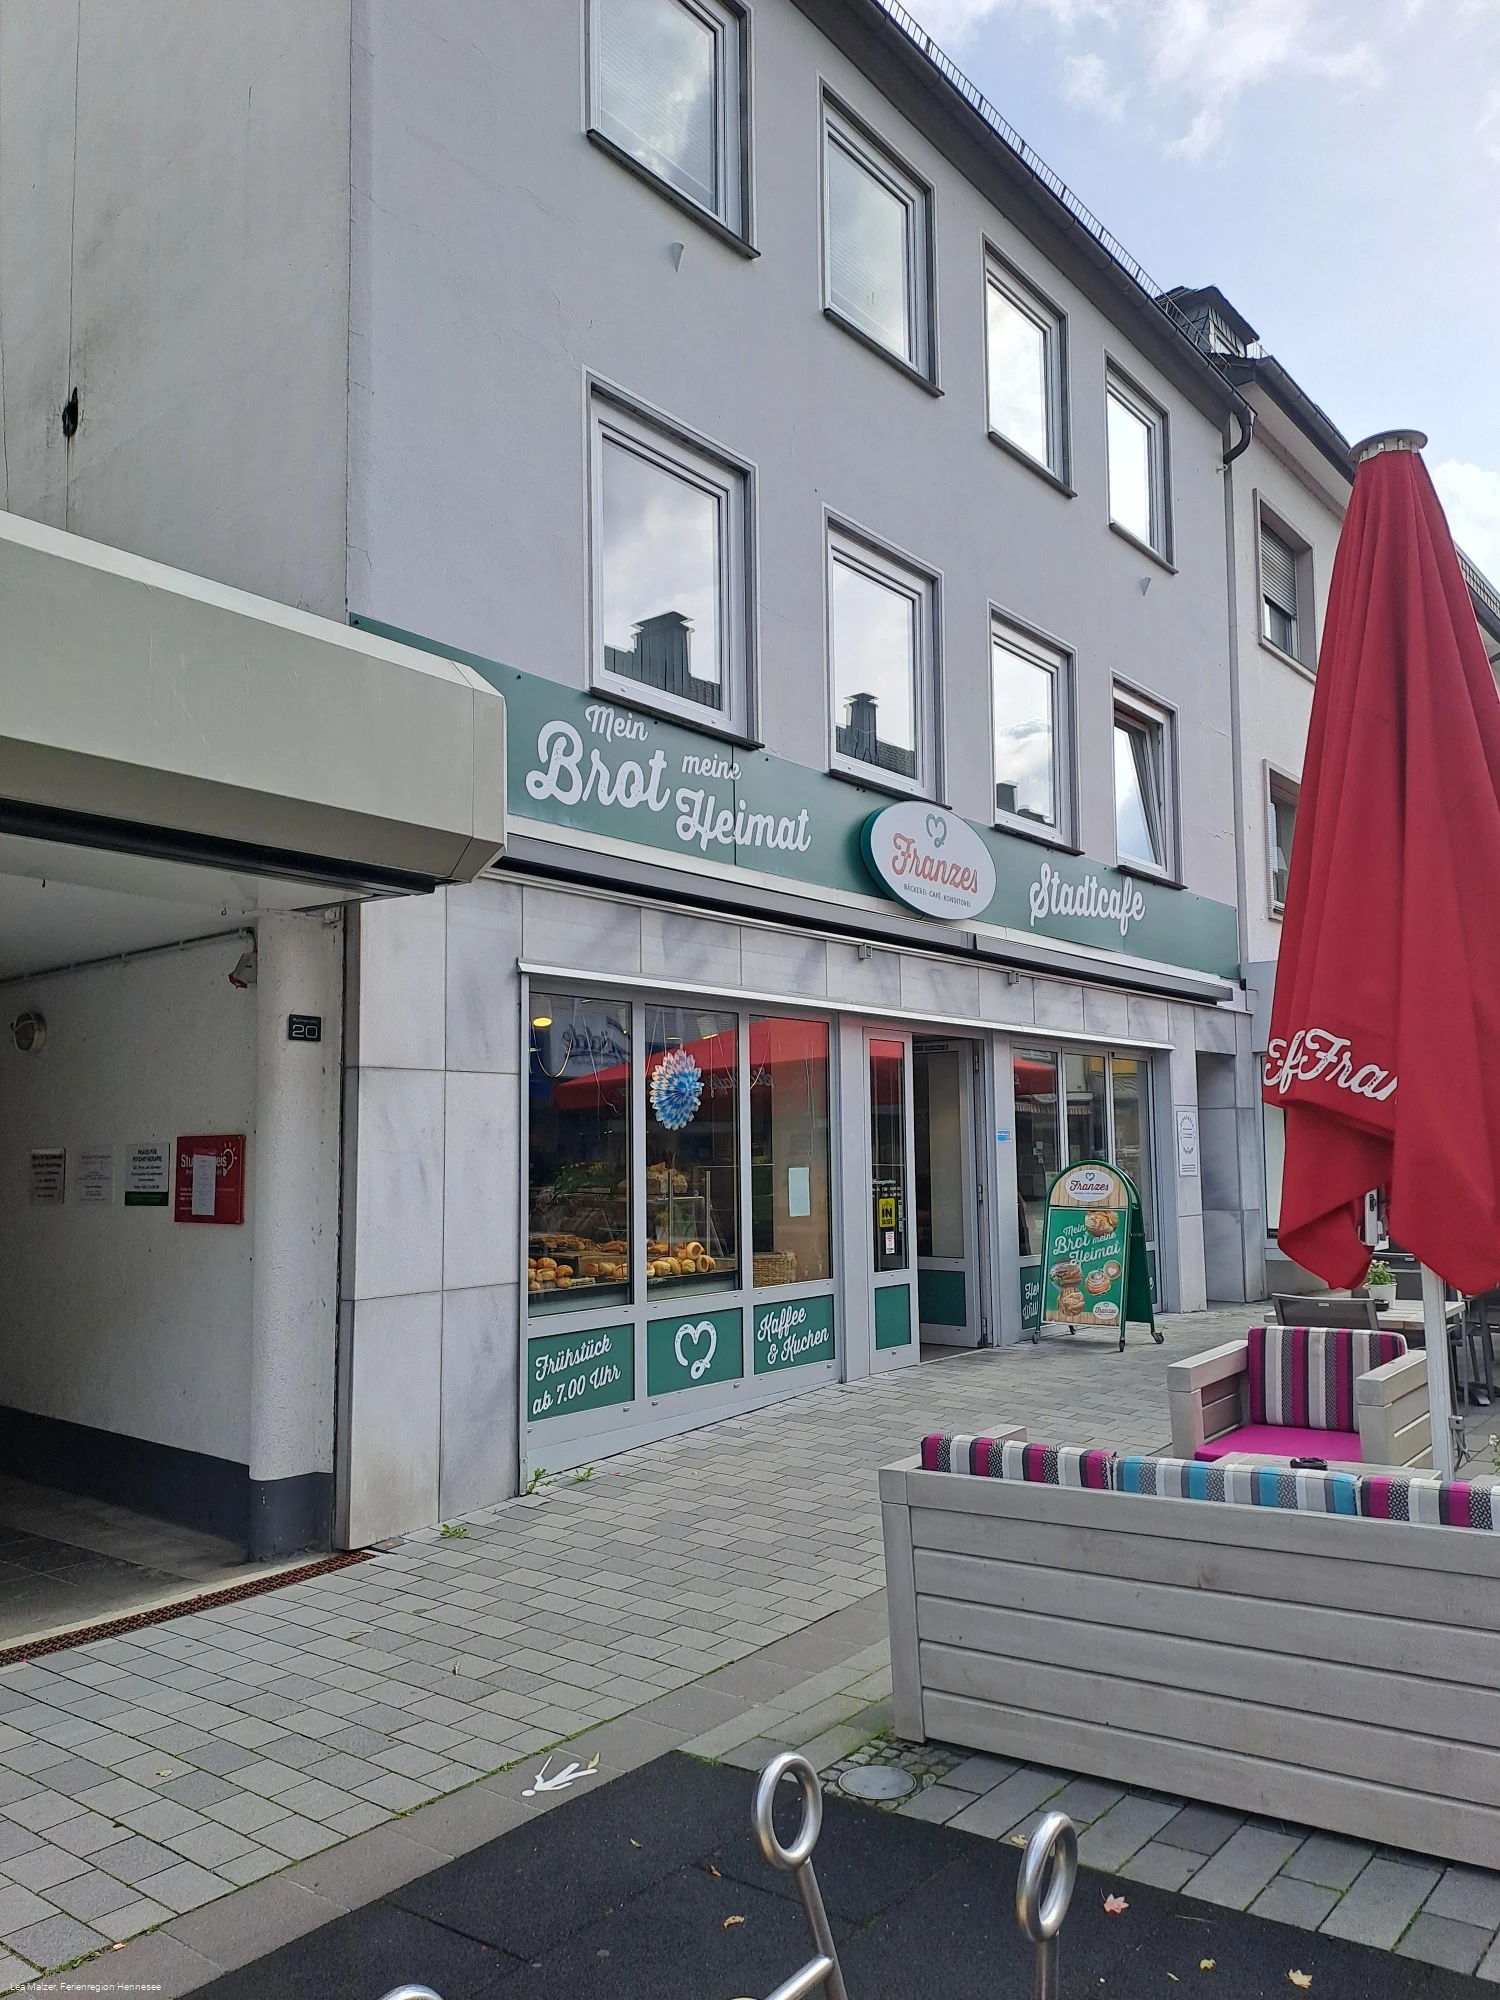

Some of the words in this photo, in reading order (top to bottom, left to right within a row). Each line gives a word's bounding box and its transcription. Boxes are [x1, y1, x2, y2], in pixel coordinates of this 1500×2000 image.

[585, 704, 648, 742] Mein
[525, 720, 671, 812] Brot
[681, 753, 742, 781] meine
[675, 788, 812, 851] Heimat
[891, 832, 979, 894] Franzes
[1029, 862, 1146, 936] Stadtcafe
[292, 1024, 318, 1039] 20
[1069, 1179, 1109, 1191] Franzes
[881, 1208, 893, 1218] IN
[1063, 1223, 1087, 1237] Mein
[1052, 1231, 1091, 1256] Brot
[1068, 1240, 1122, 1266] Heimat
[1092, 1231, 1117, 1245] meine
[757, 1305, 807, 1344] Kaffee
[535, 1333, 612, 1382] Frühstück
[767, 1343, 779, 1365] &
[781, 1326, 830, 1362] Kuchen
[532, 1388, 554, 1415] ab
[556, 1377, 586, 1405] 7.00
[589, 1362, 622, 1391] Uhr
